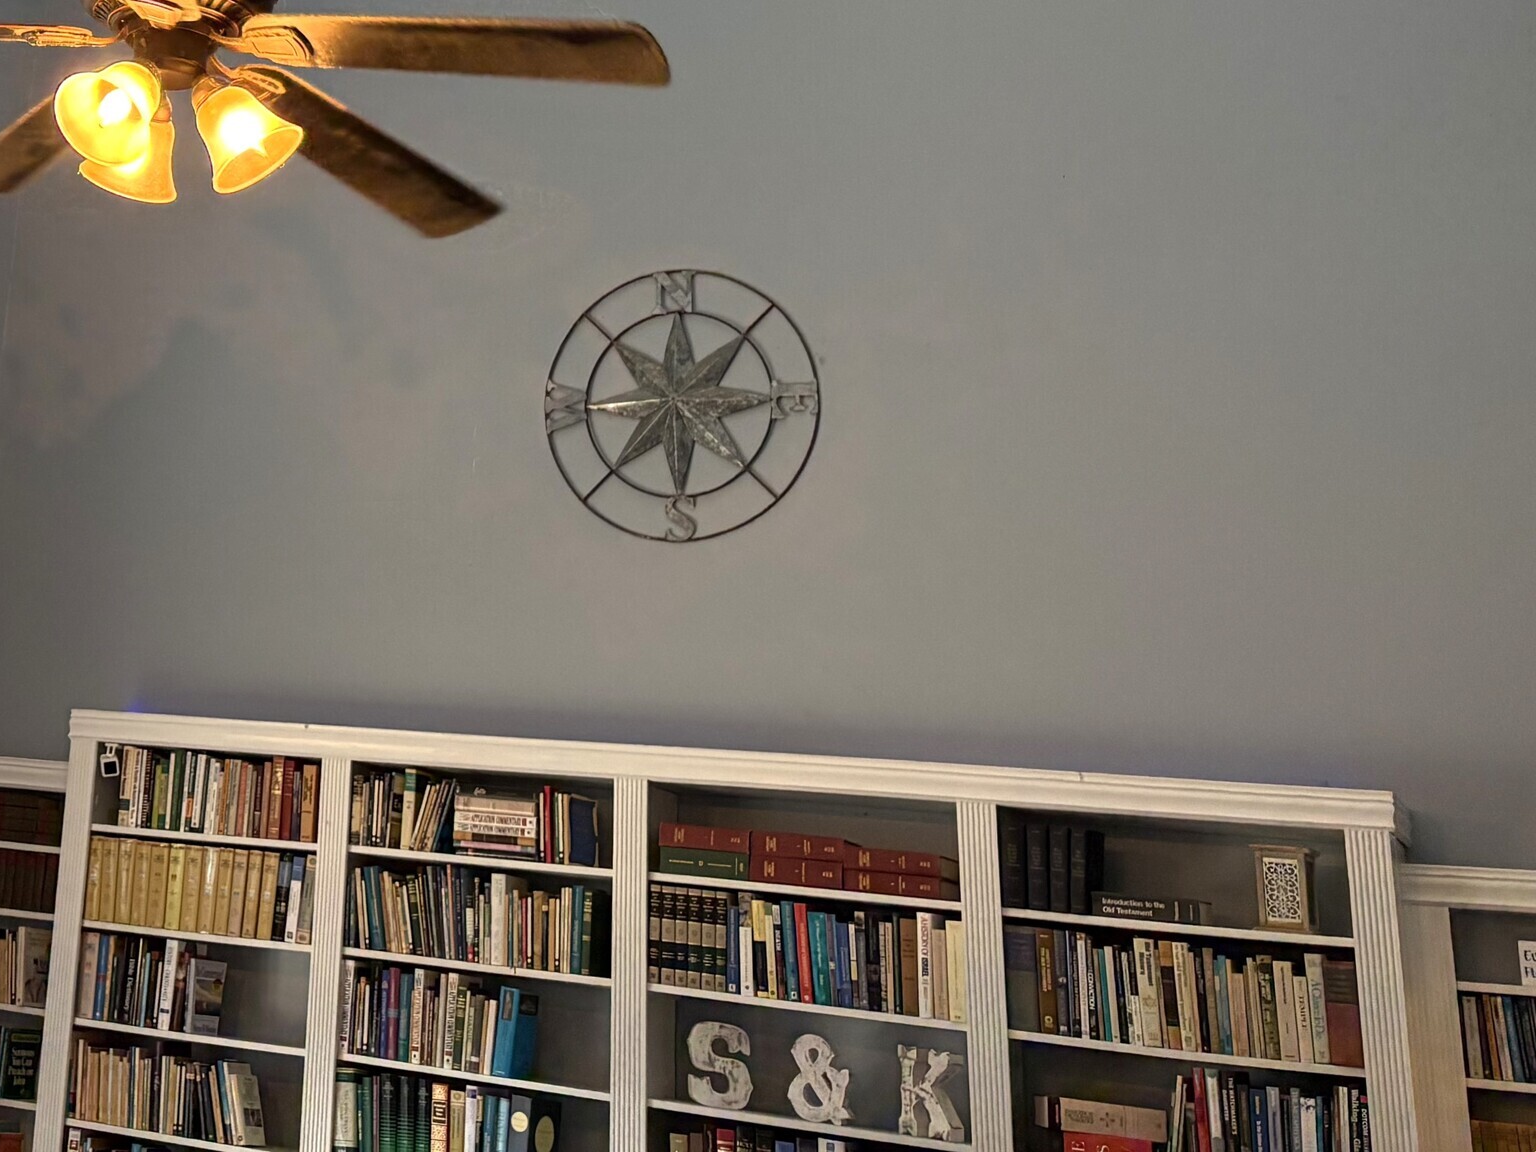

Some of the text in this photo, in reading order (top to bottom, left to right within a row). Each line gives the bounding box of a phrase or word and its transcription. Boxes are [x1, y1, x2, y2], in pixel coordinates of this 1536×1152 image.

[652, 270, 696, 314] N
[665, 496, 697, 541] S
[1102, 897, 1165, 909] Introduction to the
[1102, 906, 1153, 917] Old Testament
[686, 1021, 951, 1141] S & K
[1351, 1089, 1359, 1122] Walking
